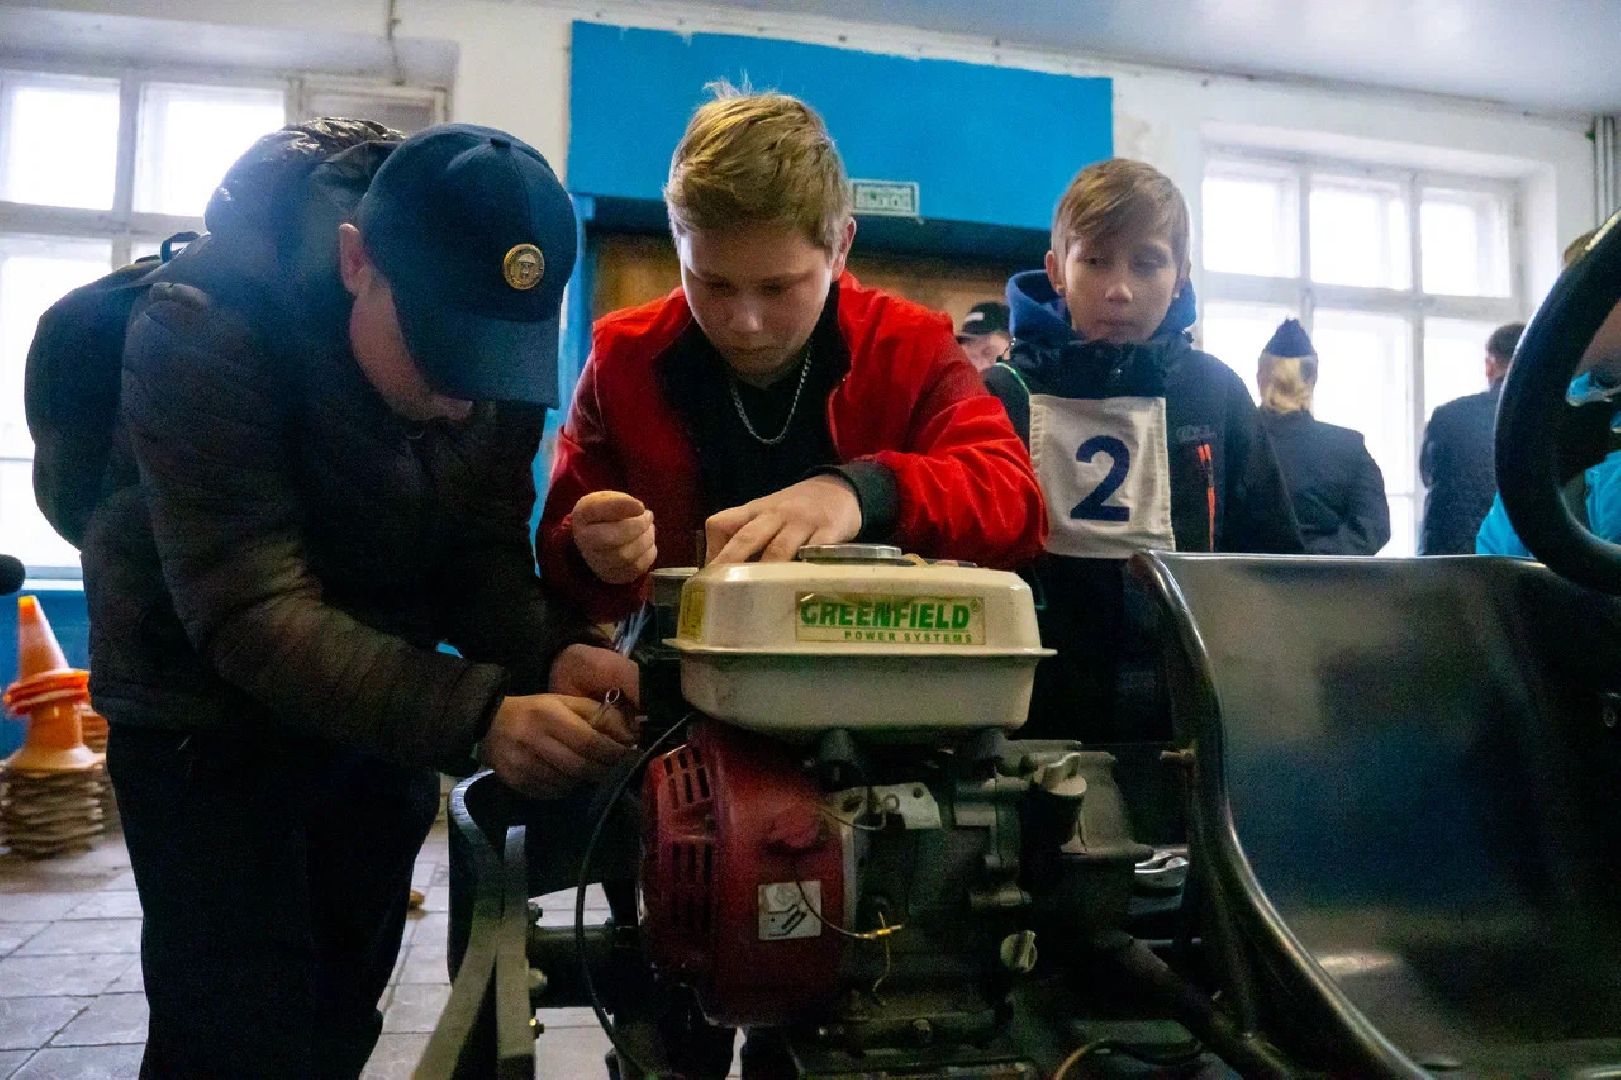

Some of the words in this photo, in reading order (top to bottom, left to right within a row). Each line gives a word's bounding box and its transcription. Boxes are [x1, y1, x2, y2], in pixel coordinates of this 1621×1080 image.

[1070, 435, 1130, 522] 2
[801, 600, 970, 629] GREENFIELD
[844, 631, 896, 641] POWER
[904, 632, 972, 644] SYSTEMS
